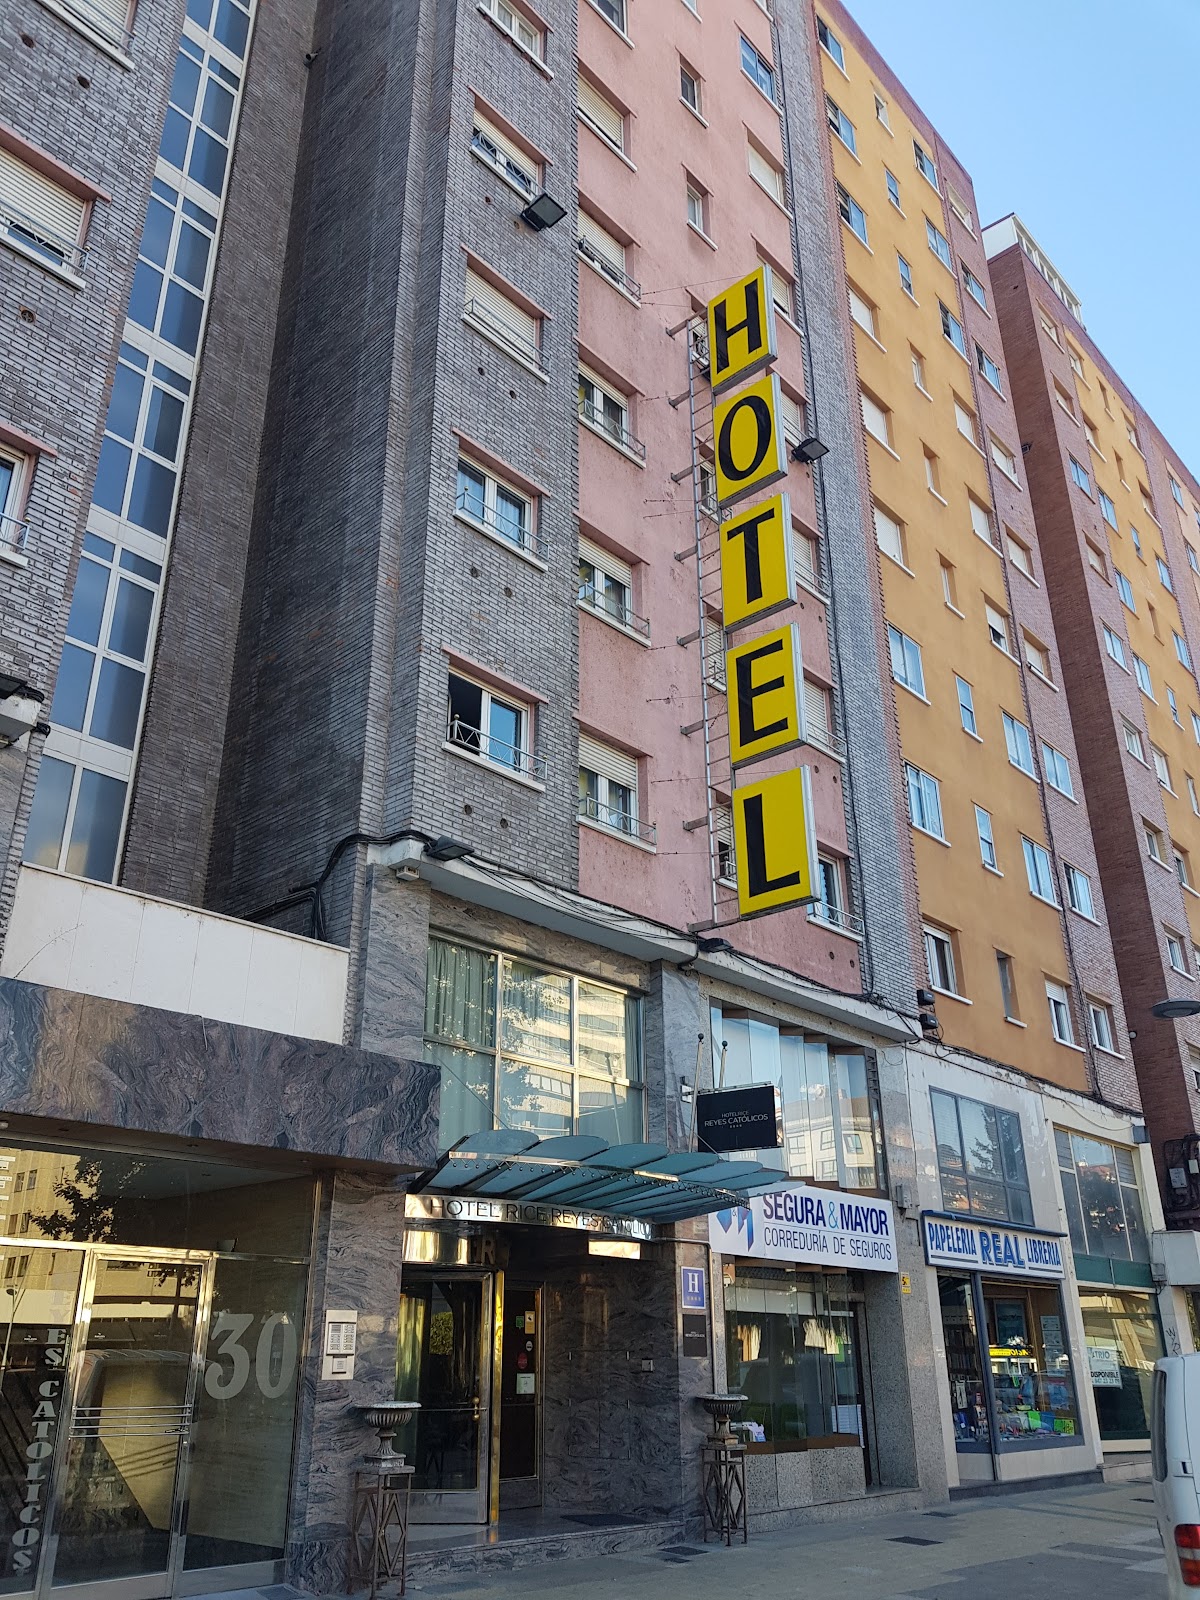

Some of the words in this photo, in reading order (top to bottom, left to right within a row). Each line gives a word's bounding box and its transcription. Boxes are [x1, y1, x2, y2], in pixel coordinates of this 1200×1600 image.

[714, 277, 800, 898] HOTEL
[705, 1119, 727, 1127] REYES
[728, 1114, 768, 1124] CATÓLICOS
[431, 1197, 500, 1218] HOTEL
[506, 1203, 547, 1222] RICE
[551, 1208, 599, 1228] REYES
[763, 1192, 826, 1227] SEGURA
[840, 1203, 889, 1236] MAYOR
[764, 1226, 828, 1253] CORREDURÍA
[833, 1237, 846, 1255] DE
[850, 1239, 892, 1260] SEGUROS
[928, 1222, 977, 1255] PAPELERIA
[978, 1229, 1026, 1269] REAL
[1025, 1238, 1061, 1266] LIBRERIA
[688, 1272, 700, 1293] H
[205, 1312, 298, 1400] 30
[1090, 1371, 1119, 1379] DISPONIBLE
[12, 1380, 60, 1574] CATOLICOS
